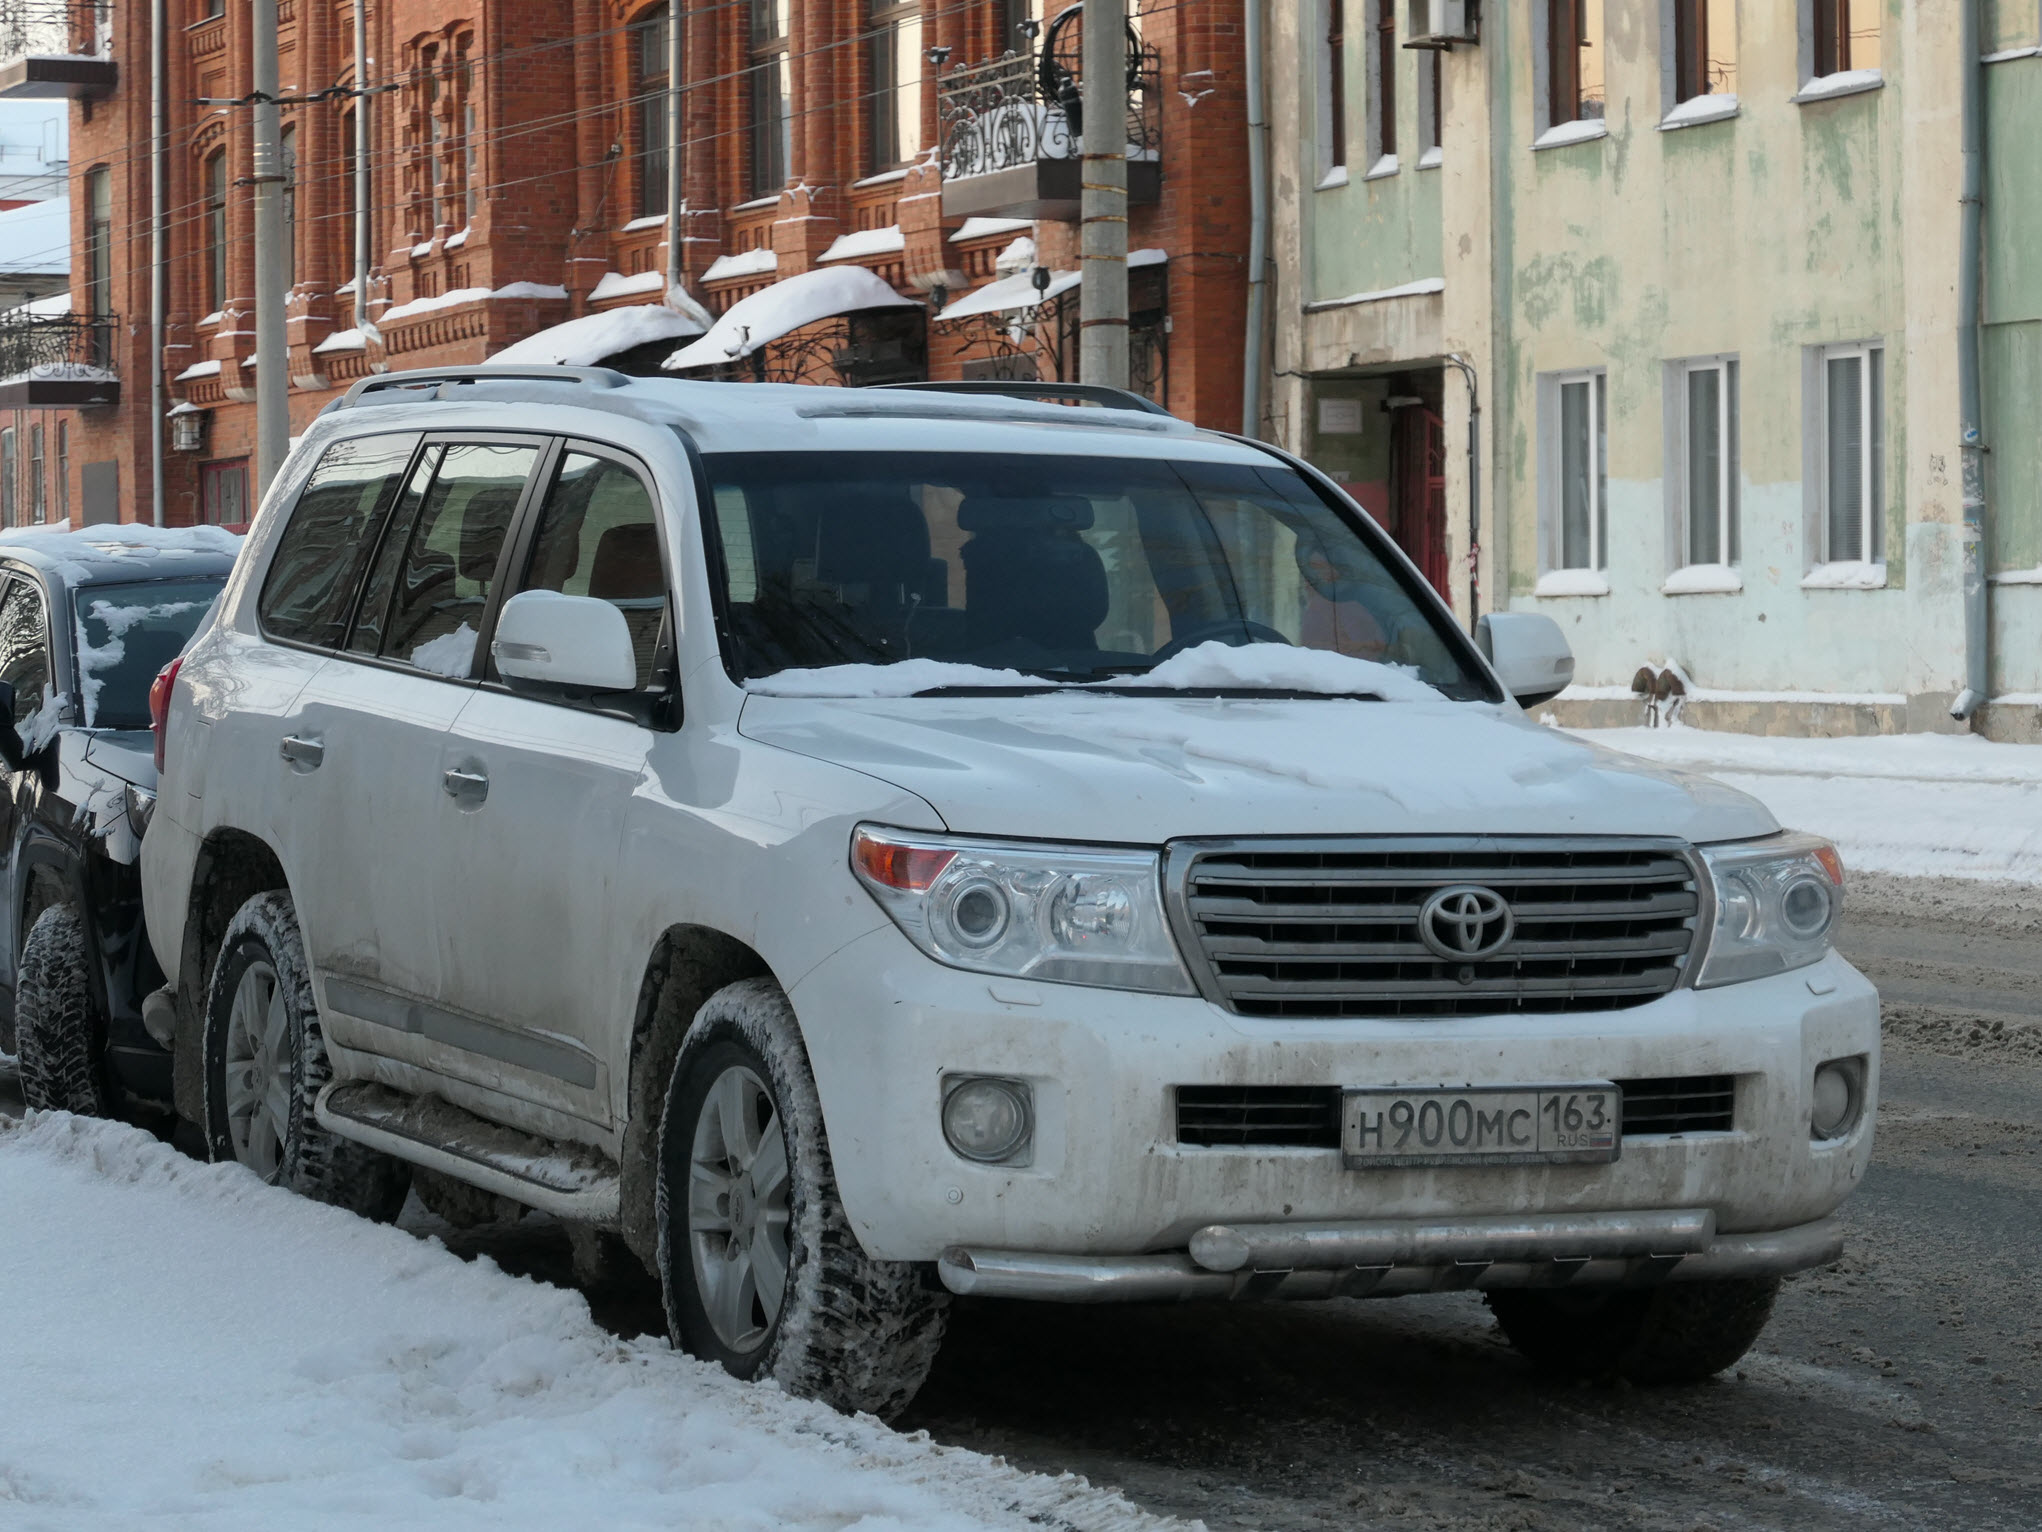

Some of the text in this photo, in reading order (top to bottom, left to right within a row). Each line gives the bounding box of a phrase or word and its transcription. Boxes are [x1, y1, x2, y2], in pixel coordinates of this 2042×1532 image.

[1360, 1094, 1606, 1149] Н900МС 163
[1557, 1133, 1589, 1147] RUS
